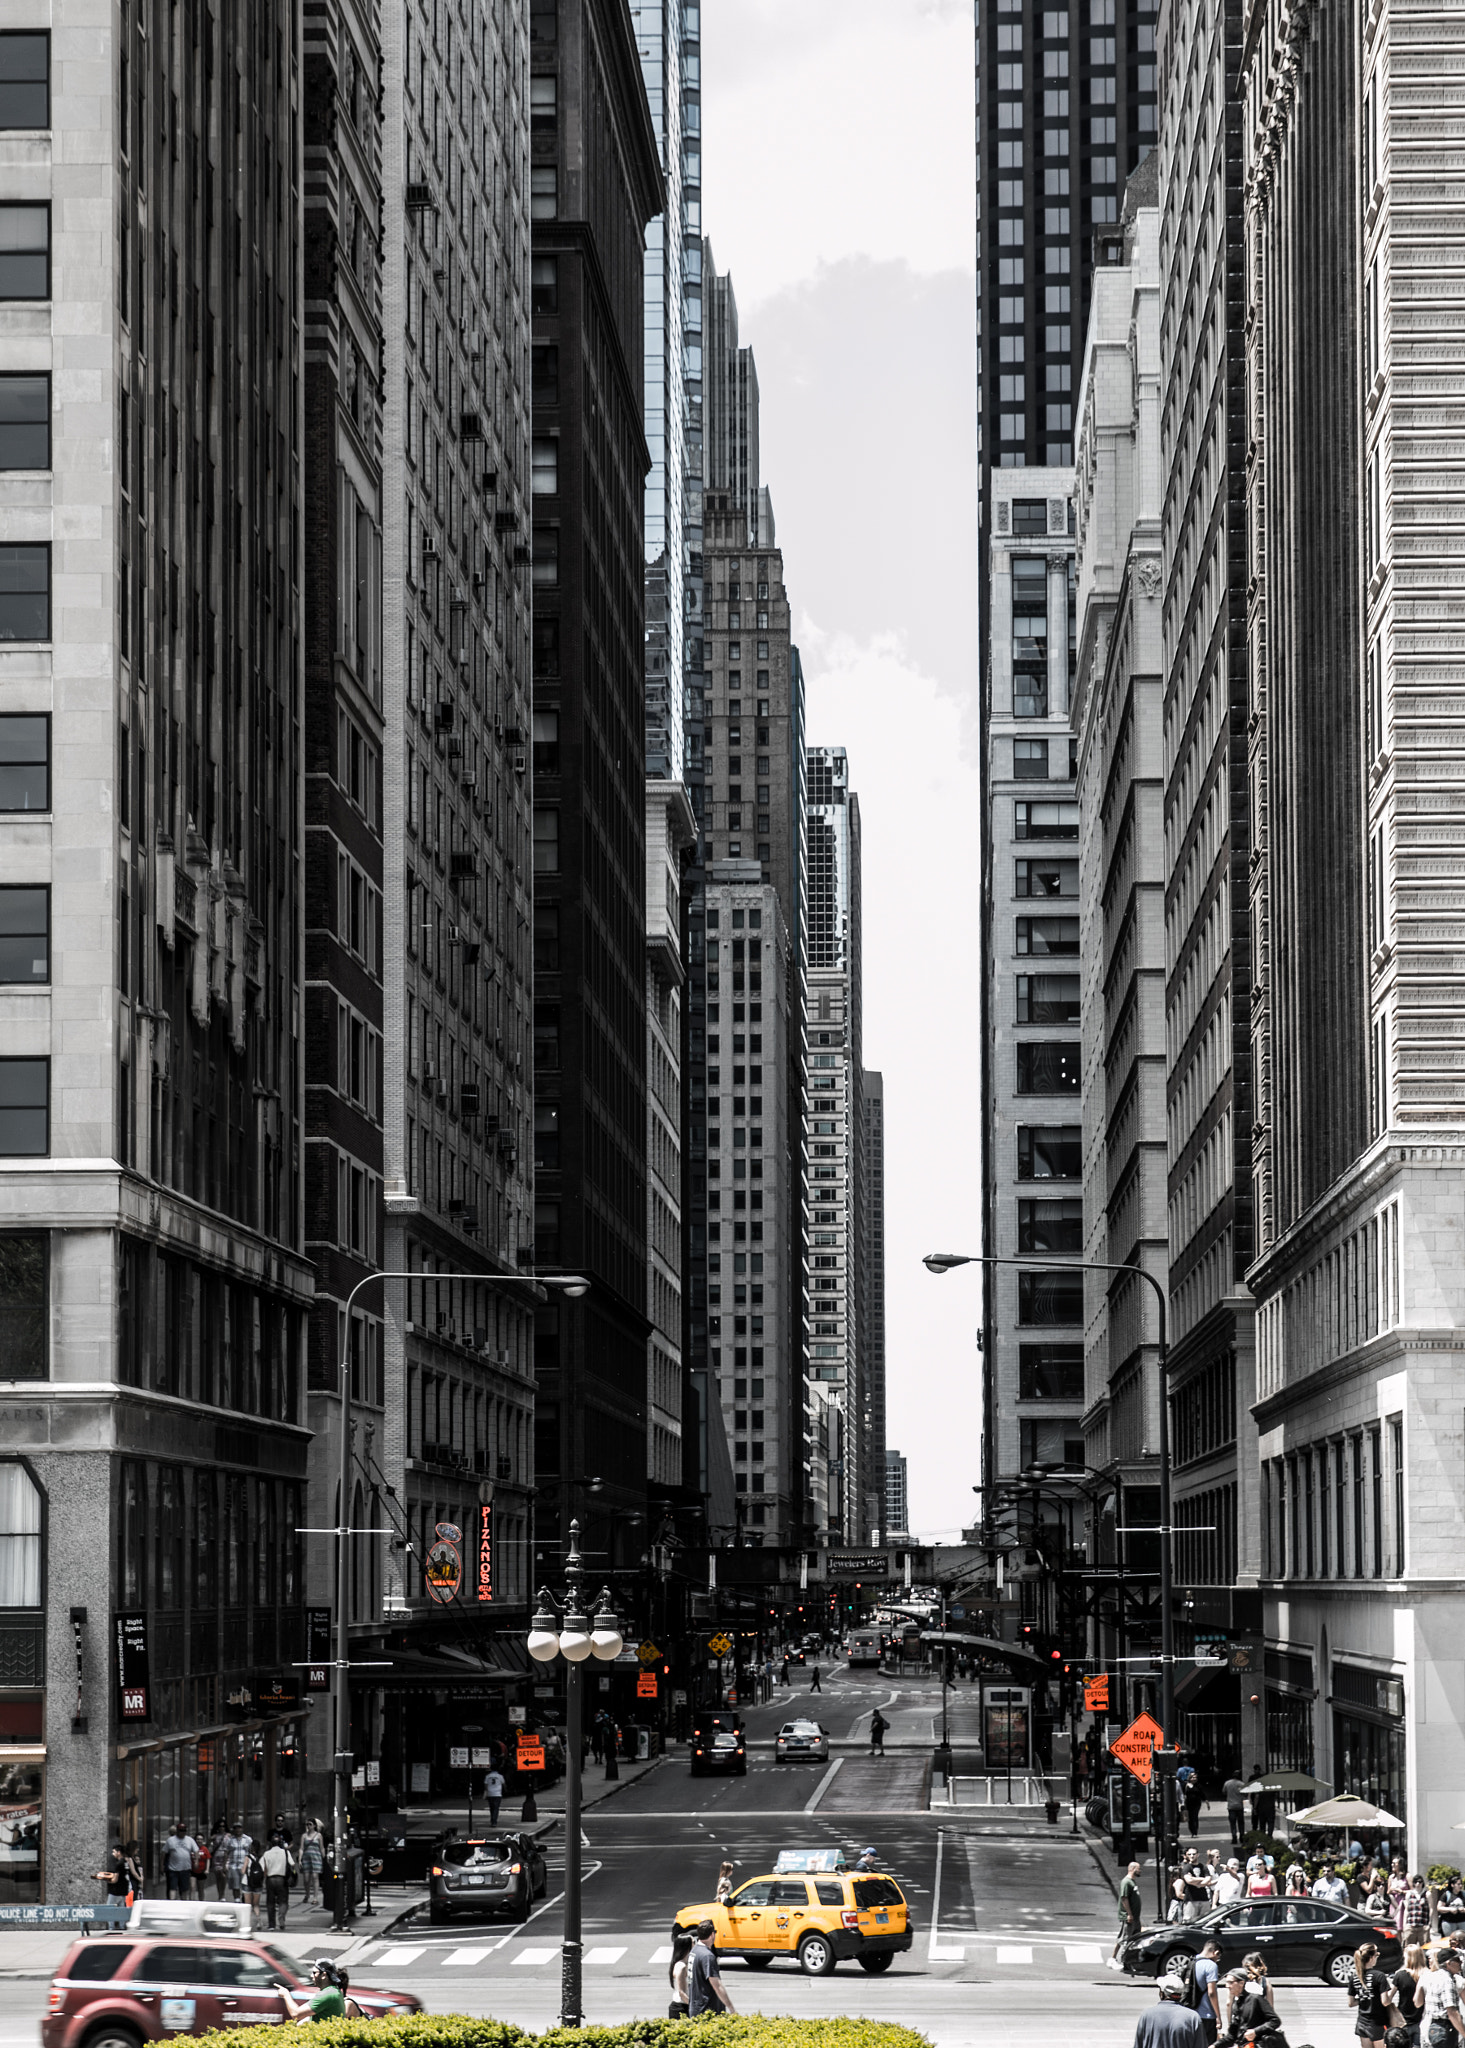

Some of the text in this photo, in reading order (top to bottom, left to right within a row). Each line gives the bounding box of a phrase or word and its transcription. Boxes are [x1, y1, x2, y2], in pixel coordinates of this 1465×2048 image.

[828, 1559, 886, 1568] Jewelers Row
[310, 1671, 325, 1681] MR
[124, 1695, 143, 1709] MR
[1133, 1731, 1156, 1739] ROAD
[6, 1809, 29, 1819] rates
[56, 1909, 70, 1918] NOT
[72, 1908, 95, 1918] CROSS
